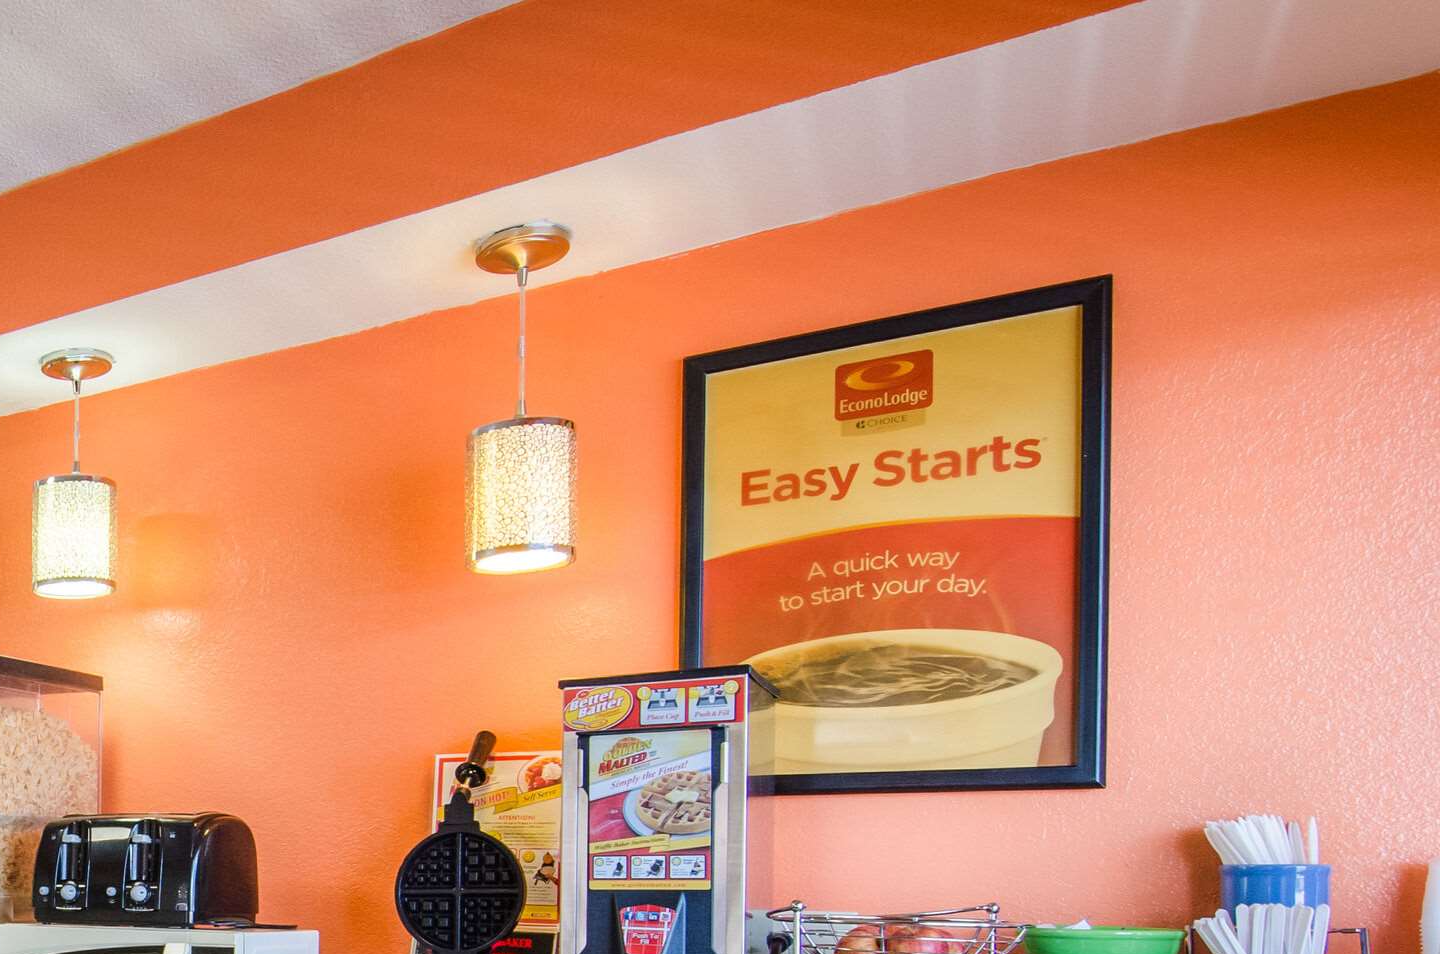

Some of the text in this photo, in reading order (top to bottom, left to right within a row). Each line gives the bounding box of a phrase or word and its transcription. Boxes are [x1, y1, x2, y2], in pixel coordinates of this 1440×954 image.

[839, 388, 929, 414] EconoLodge
[867, 415, 909, 428] CHOICE
[741, 436, 1042, 507] Easy Starts
[807, 550, 961, 582] A quick way
[779, 573, 988, 612] to start your day.
[598, 752, 648, 775] MALTED
[642, 769, 657, 780] the
